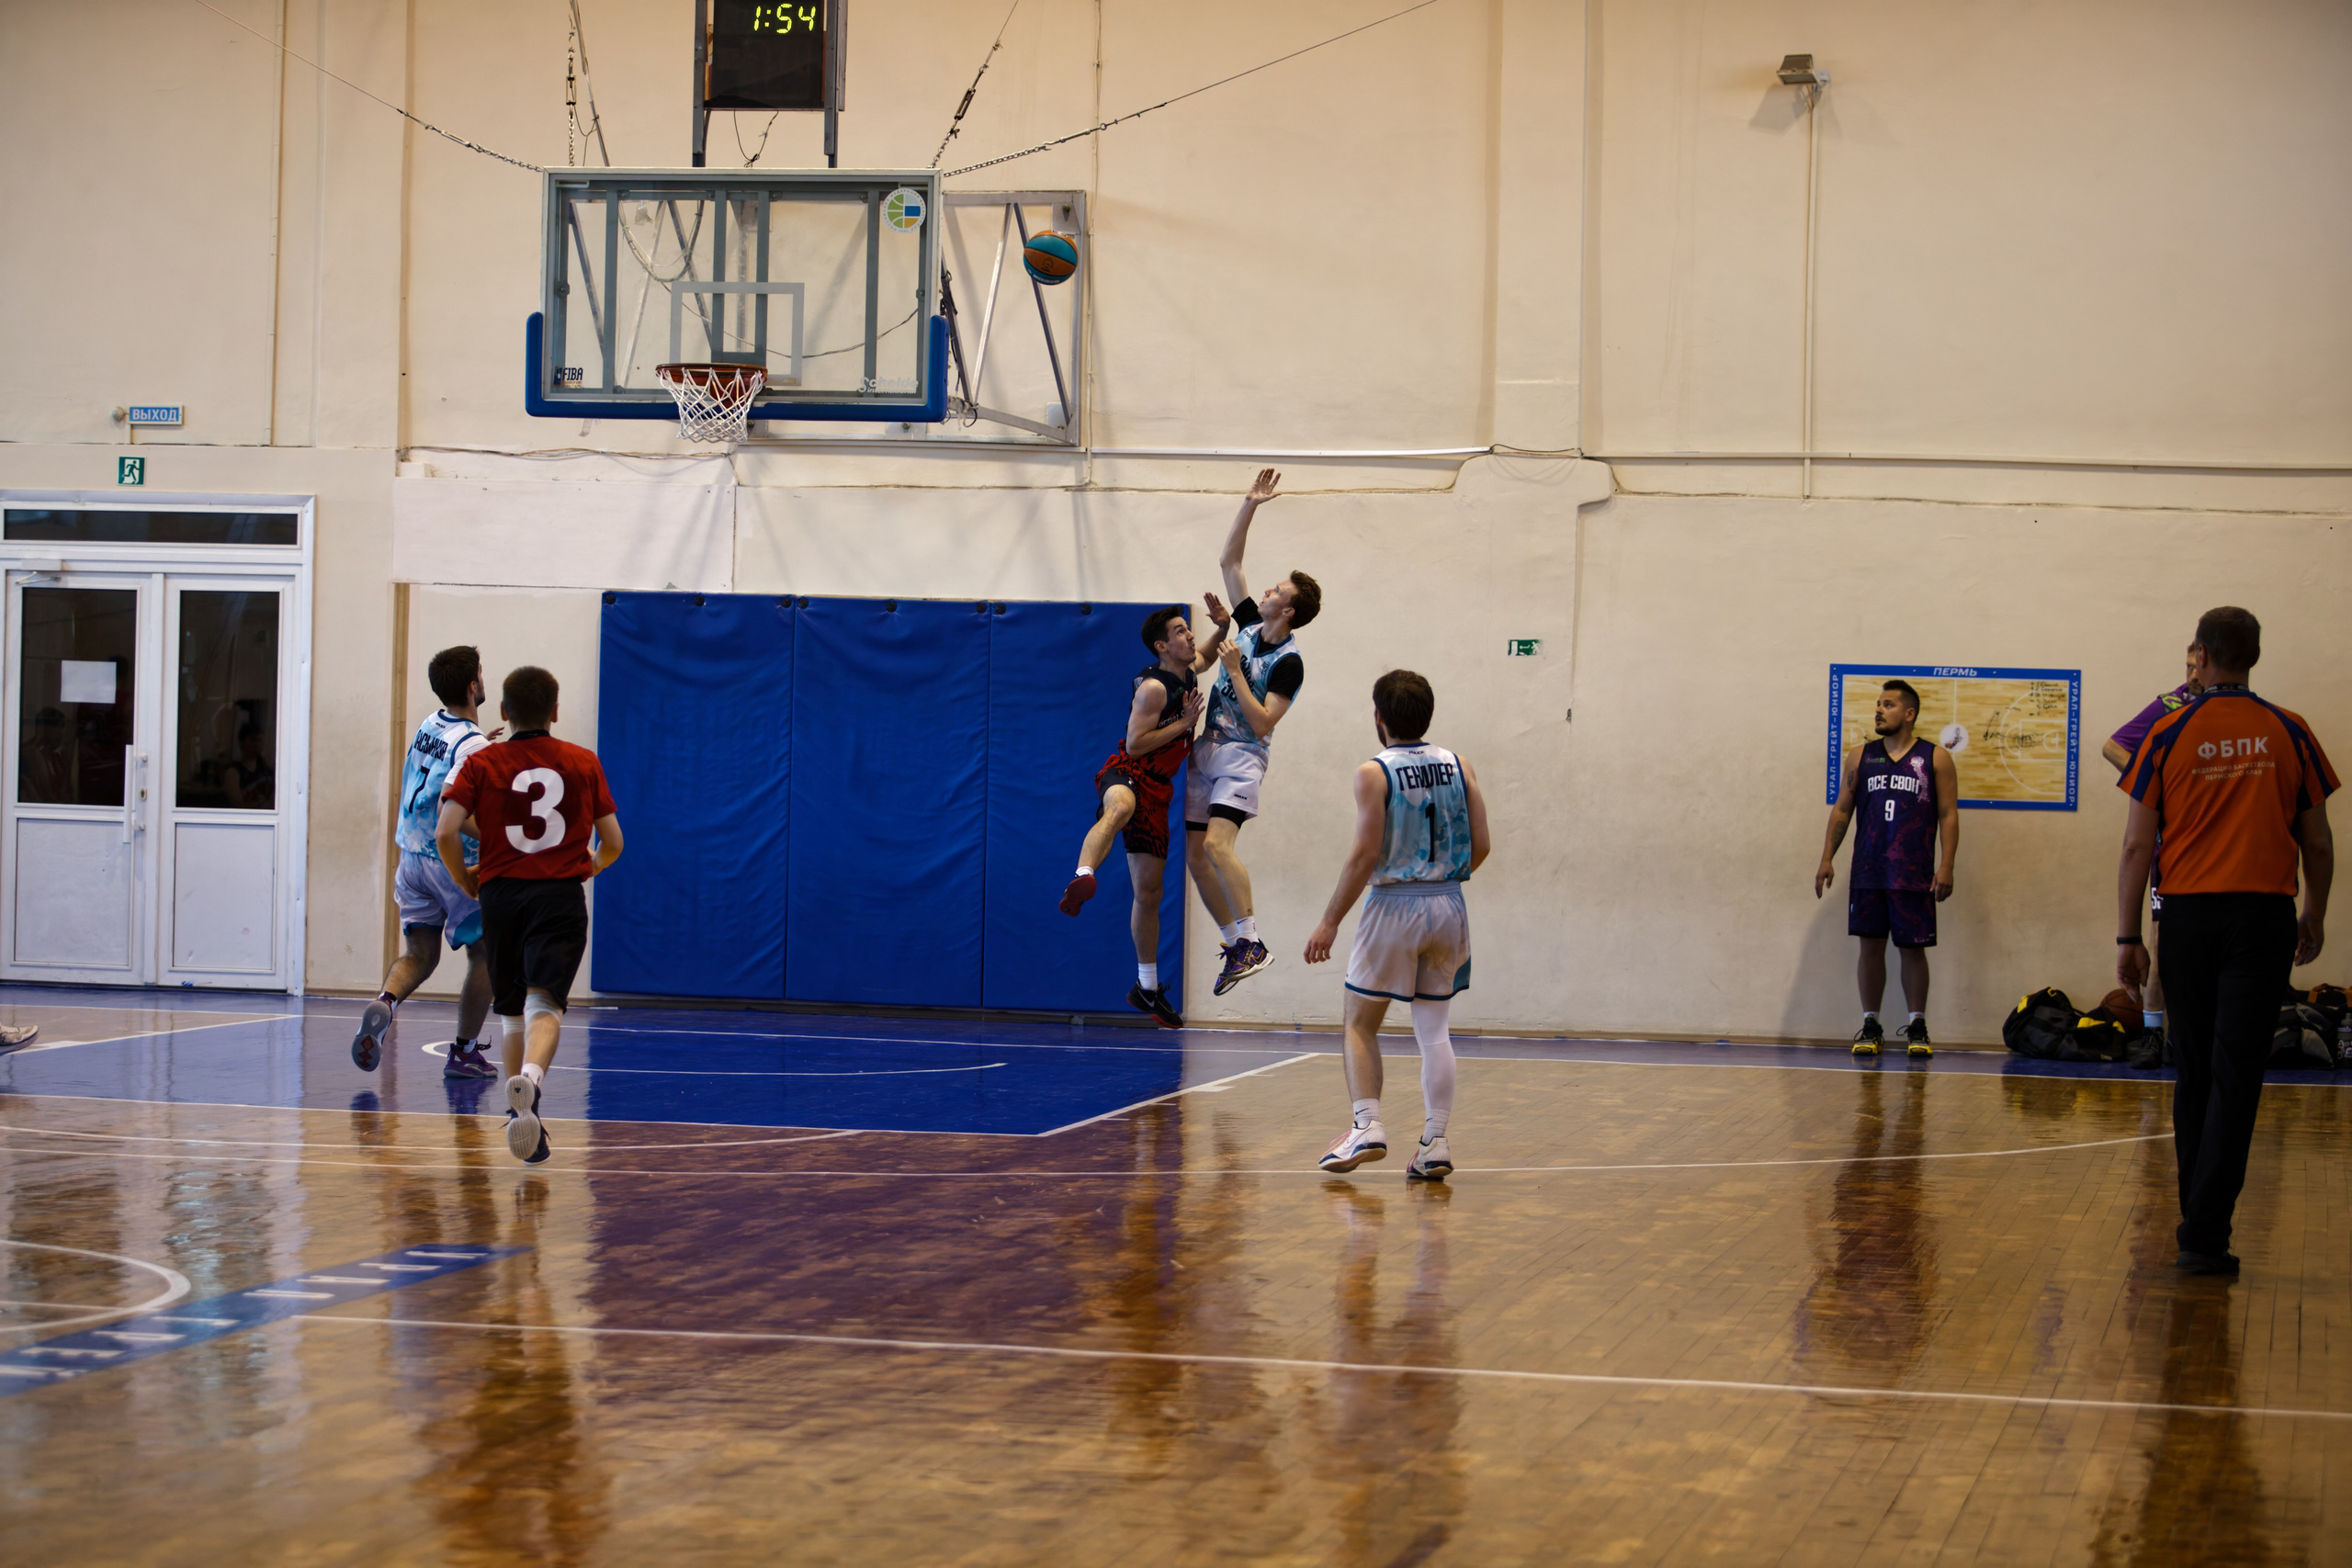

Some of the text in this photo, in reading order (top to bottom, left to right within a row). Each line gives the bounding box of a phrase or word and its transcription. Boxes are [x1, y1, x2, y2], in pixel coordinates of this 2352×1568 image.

[753, 3, 817, 34] 1:54
[562, 367, 583, 381] FIBA
[131, 408, 177, 423] ВЫХОД
[1933, 667, 1977, 677] ПЕРМЬ
[2197, 736, 2268, 760] ФБПК
[408, 765, 431, 814] 7
[1867, 774, 1888, 793] ВСЕ
[505, 767, 566, 853] 3
[1884, 799, 1895, 822] 9
[1425, 802, 1436, 863] 1
